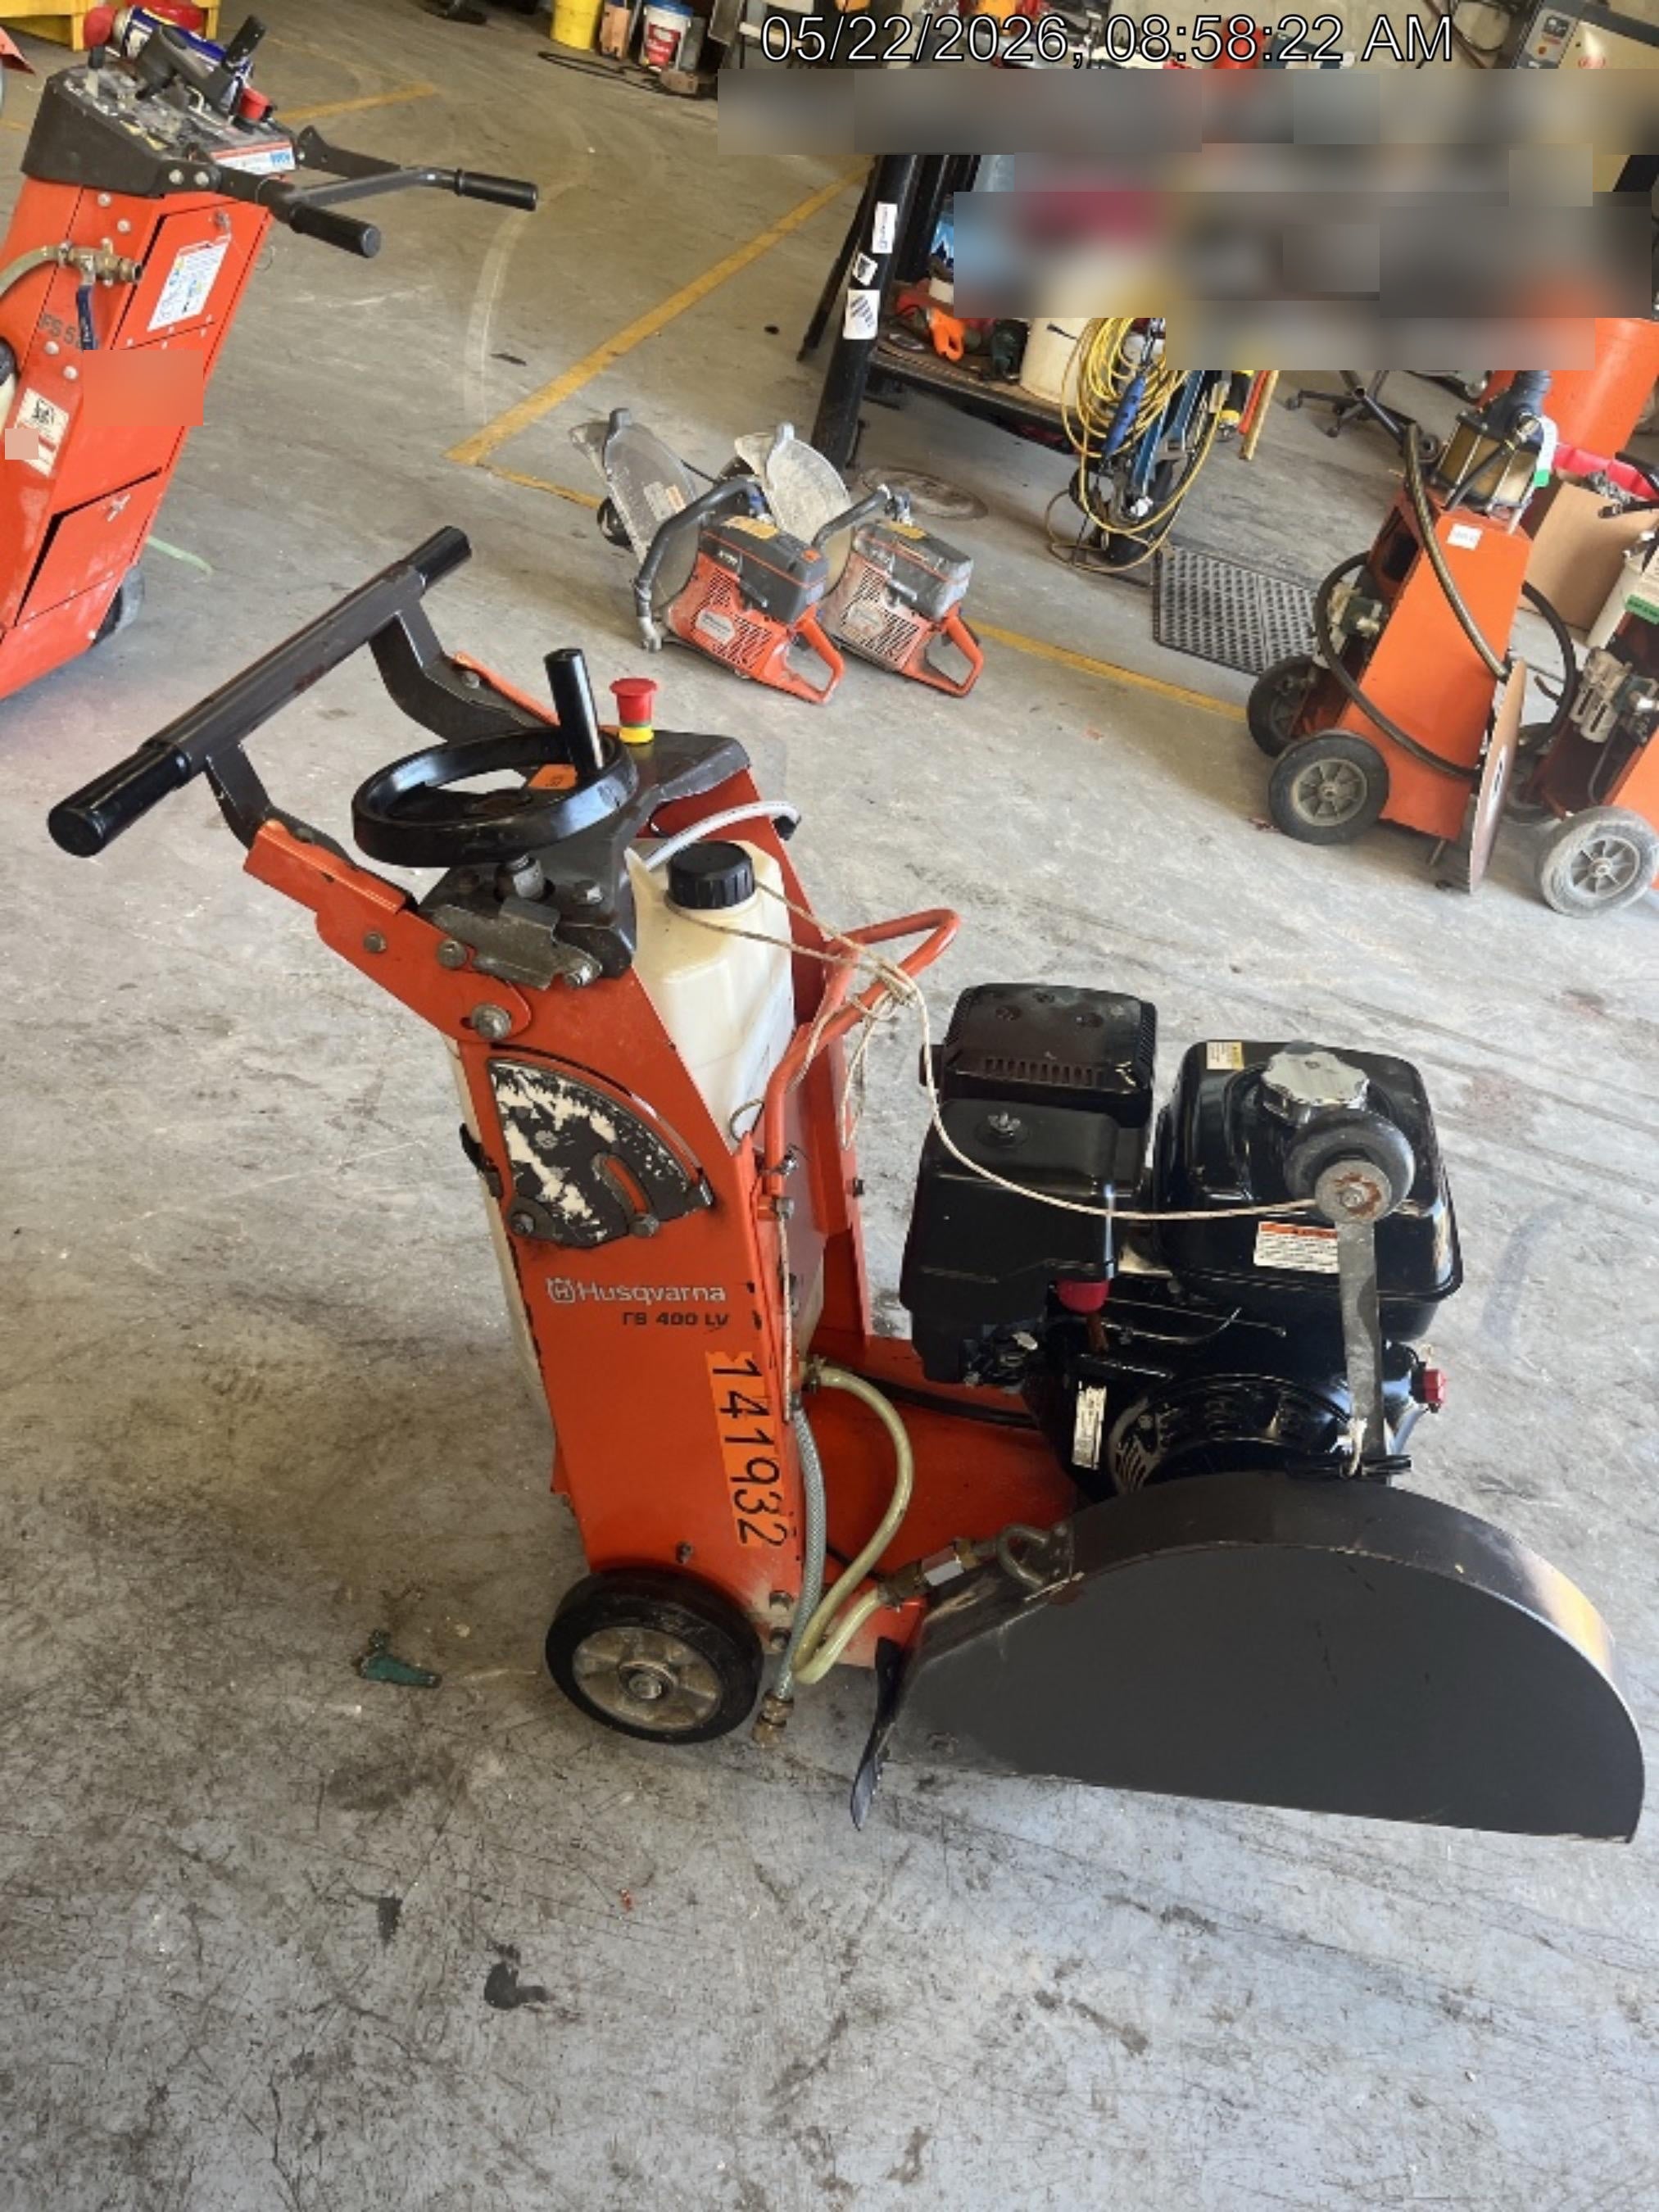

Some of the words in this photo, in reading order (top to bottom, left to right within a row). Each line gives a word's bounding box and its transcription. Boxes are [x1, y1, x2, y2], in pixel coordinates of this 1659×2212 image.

[577, 1281, 727, 1306] Husqvarna
[655, 1312, 698, 1326] 400
[705, 1313, 728, 1326] LV
[712, 1358, 787, 1547] 141932
